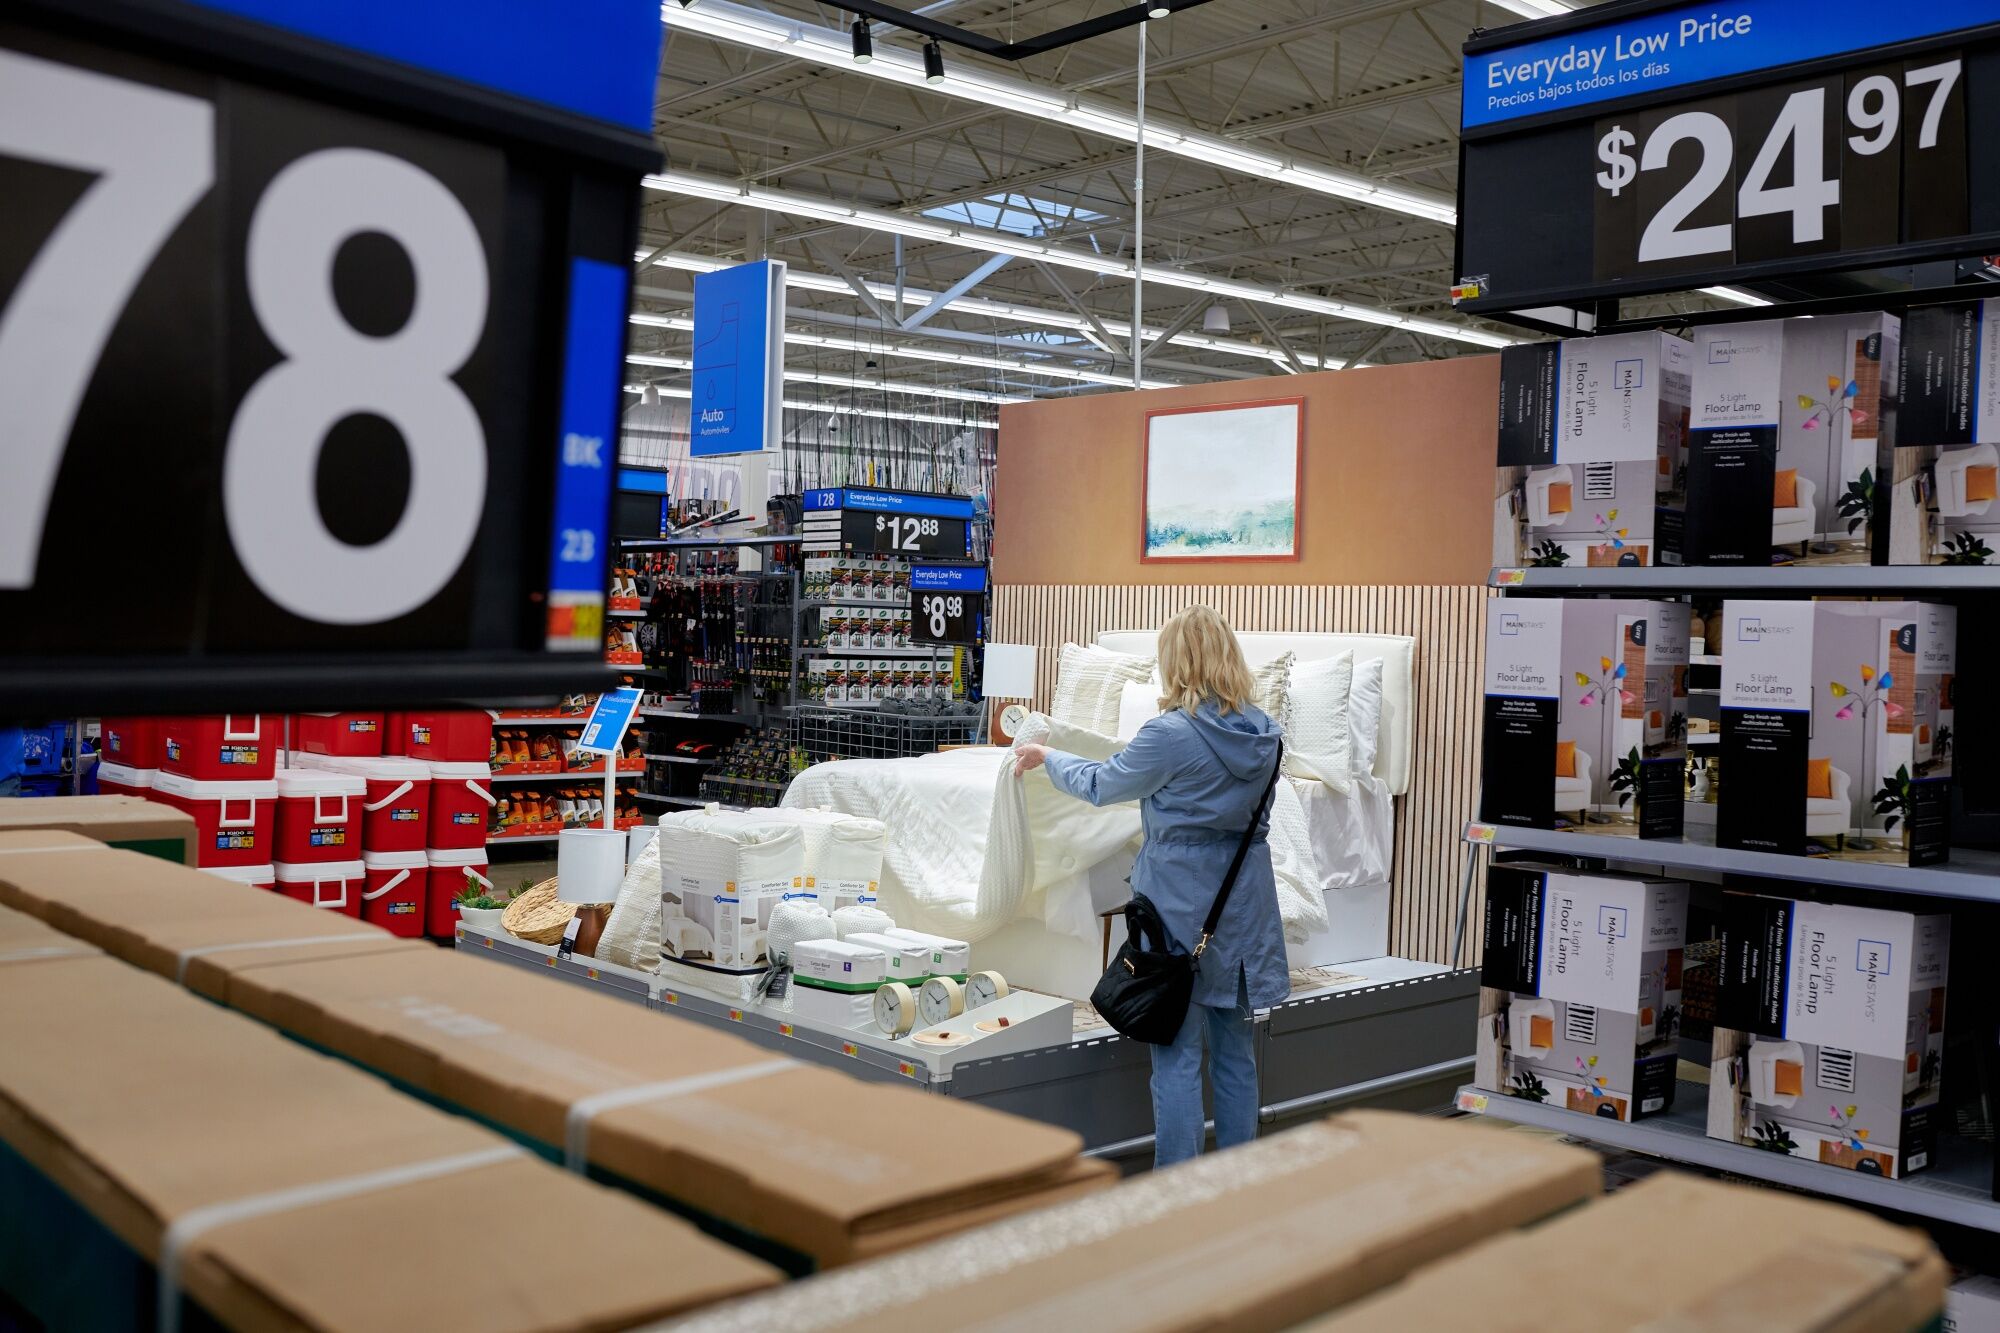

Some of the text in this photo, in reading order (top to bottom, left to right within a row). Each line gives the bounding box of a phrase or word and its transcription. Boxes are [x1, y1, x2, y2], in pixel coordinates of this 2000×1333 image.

[1488, 13, 1753, 89] Everyday Low Price
[1488, 62, 1670, 110] Precios bajos todos los días
[1868, 338, 1877, 354] Gray
[1963, 351, 1971, 367] with
[1572, 362, 1588, 437] Floor Lamp
[1587, 391, 1598, 417] Light
[1622, 370, 1633, 430] MAINSTAYS
[1720, 393, 1747, 403] 5 Light
[701, 409, 724, 423] Auto
[1705, 402, 1761, 414] Floor Lamp
[850, 492, 875, 502] Everyday
[888, 495, 903, 504] Price
[915, 569, 962, 580] Everyday Low Price
[1635, 625, 1643, 639] Gray
[1902, 630, 1912, 645] Gray
[1510, 664, 1533, 673] 5 Light
[1497, 672, 1545, 685] Floor Lamp
[1751, 674, 1778, 684] 5 Light
[1736, 683, 1793, 696] Floor Lamp
[1532, 879, 1540, 894] Gray
[1531, 895, 1539, 913] finish
[1528, 930, 1536, 961] multicolor
[1555, 899, 1573, 974] Floor Lamp
[1571, 931, 1582, 956] Light
[1605, 916, 1616, 977] MAINSTAYS
[1527, 962, 1535, 983] shades
[1770, 909, 1785, 1024] Gray finish with multicolor shades
[1805, 931, 1825, 1014] Floor Lamp
[1823, 966, 1835, 994] Light
[1865, 951, 1878, 1019] MAINSTAYS
